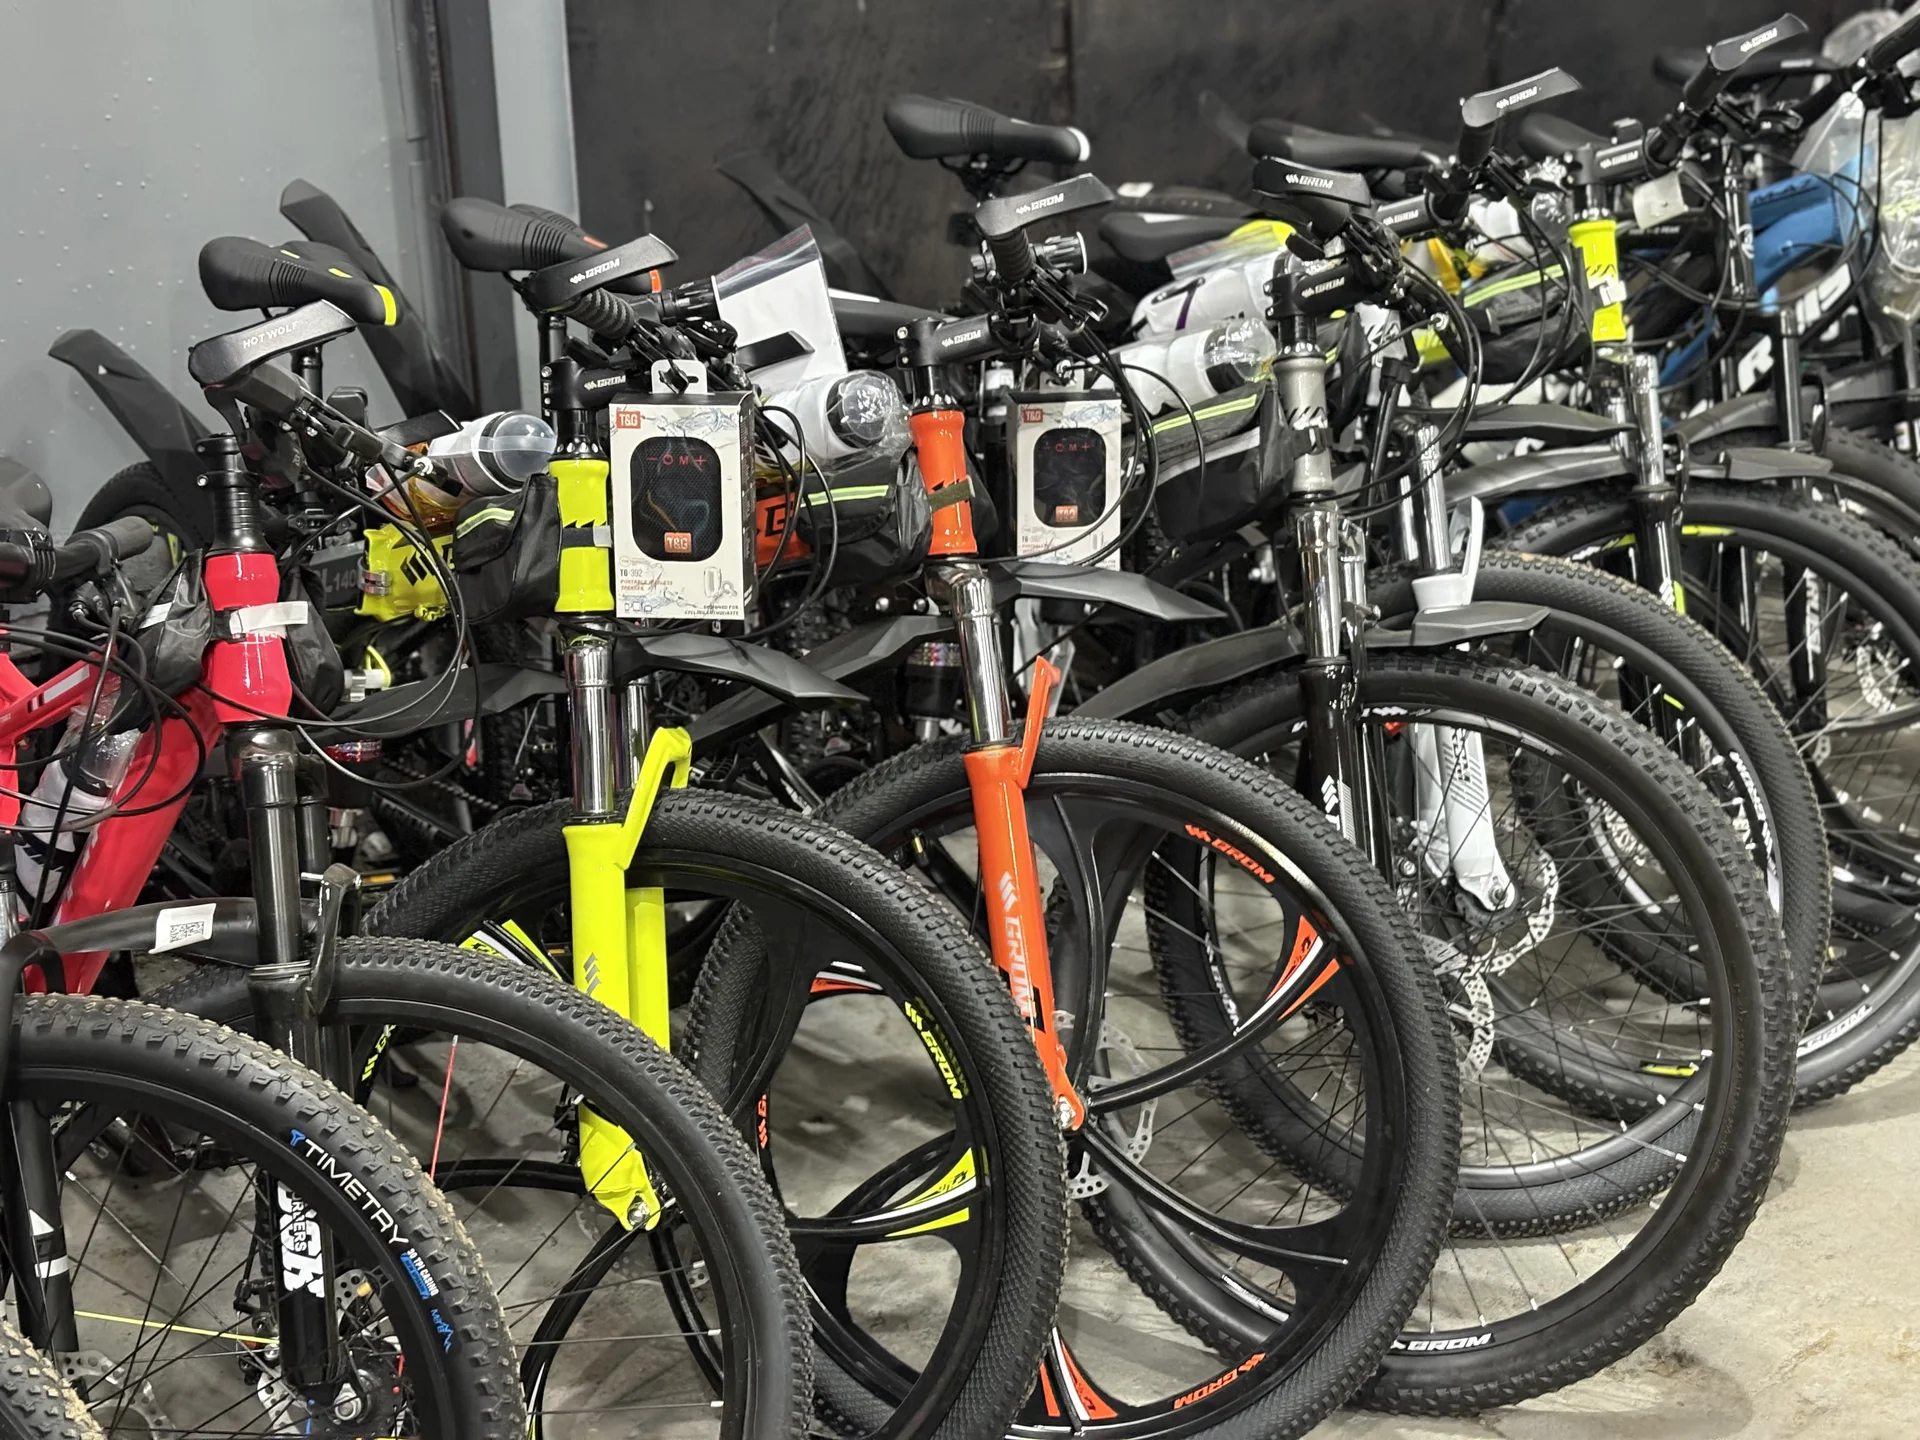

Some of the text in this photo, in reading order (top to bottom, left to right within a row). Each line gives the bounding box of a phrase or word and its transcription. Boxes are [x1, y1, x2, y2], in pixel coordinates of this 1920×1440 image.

[1030, 192, 1064, 211] GROM
[585, 257, 620, 279] GROM
[242, 320, 299, 350] HOT WOLF
[619, 413, 640, 427] T&G
[1025, 409, 1042, 421] T&G
[679, 455, 689, 466] M
[666, 537, 689, 550] T&G
[1211, 837, 1276, 884] GROM
[1004, 915, 1035, 1019] GROM
[920, 1029, 963, 1099] GROM
[305, 1138, 410, 1244] TIMETRY
[413, 1256, 426, 1271] TPI
[1407, 1332, 1493, 1351] GROM
[1173, 1367, 1239, 1410] GROM
